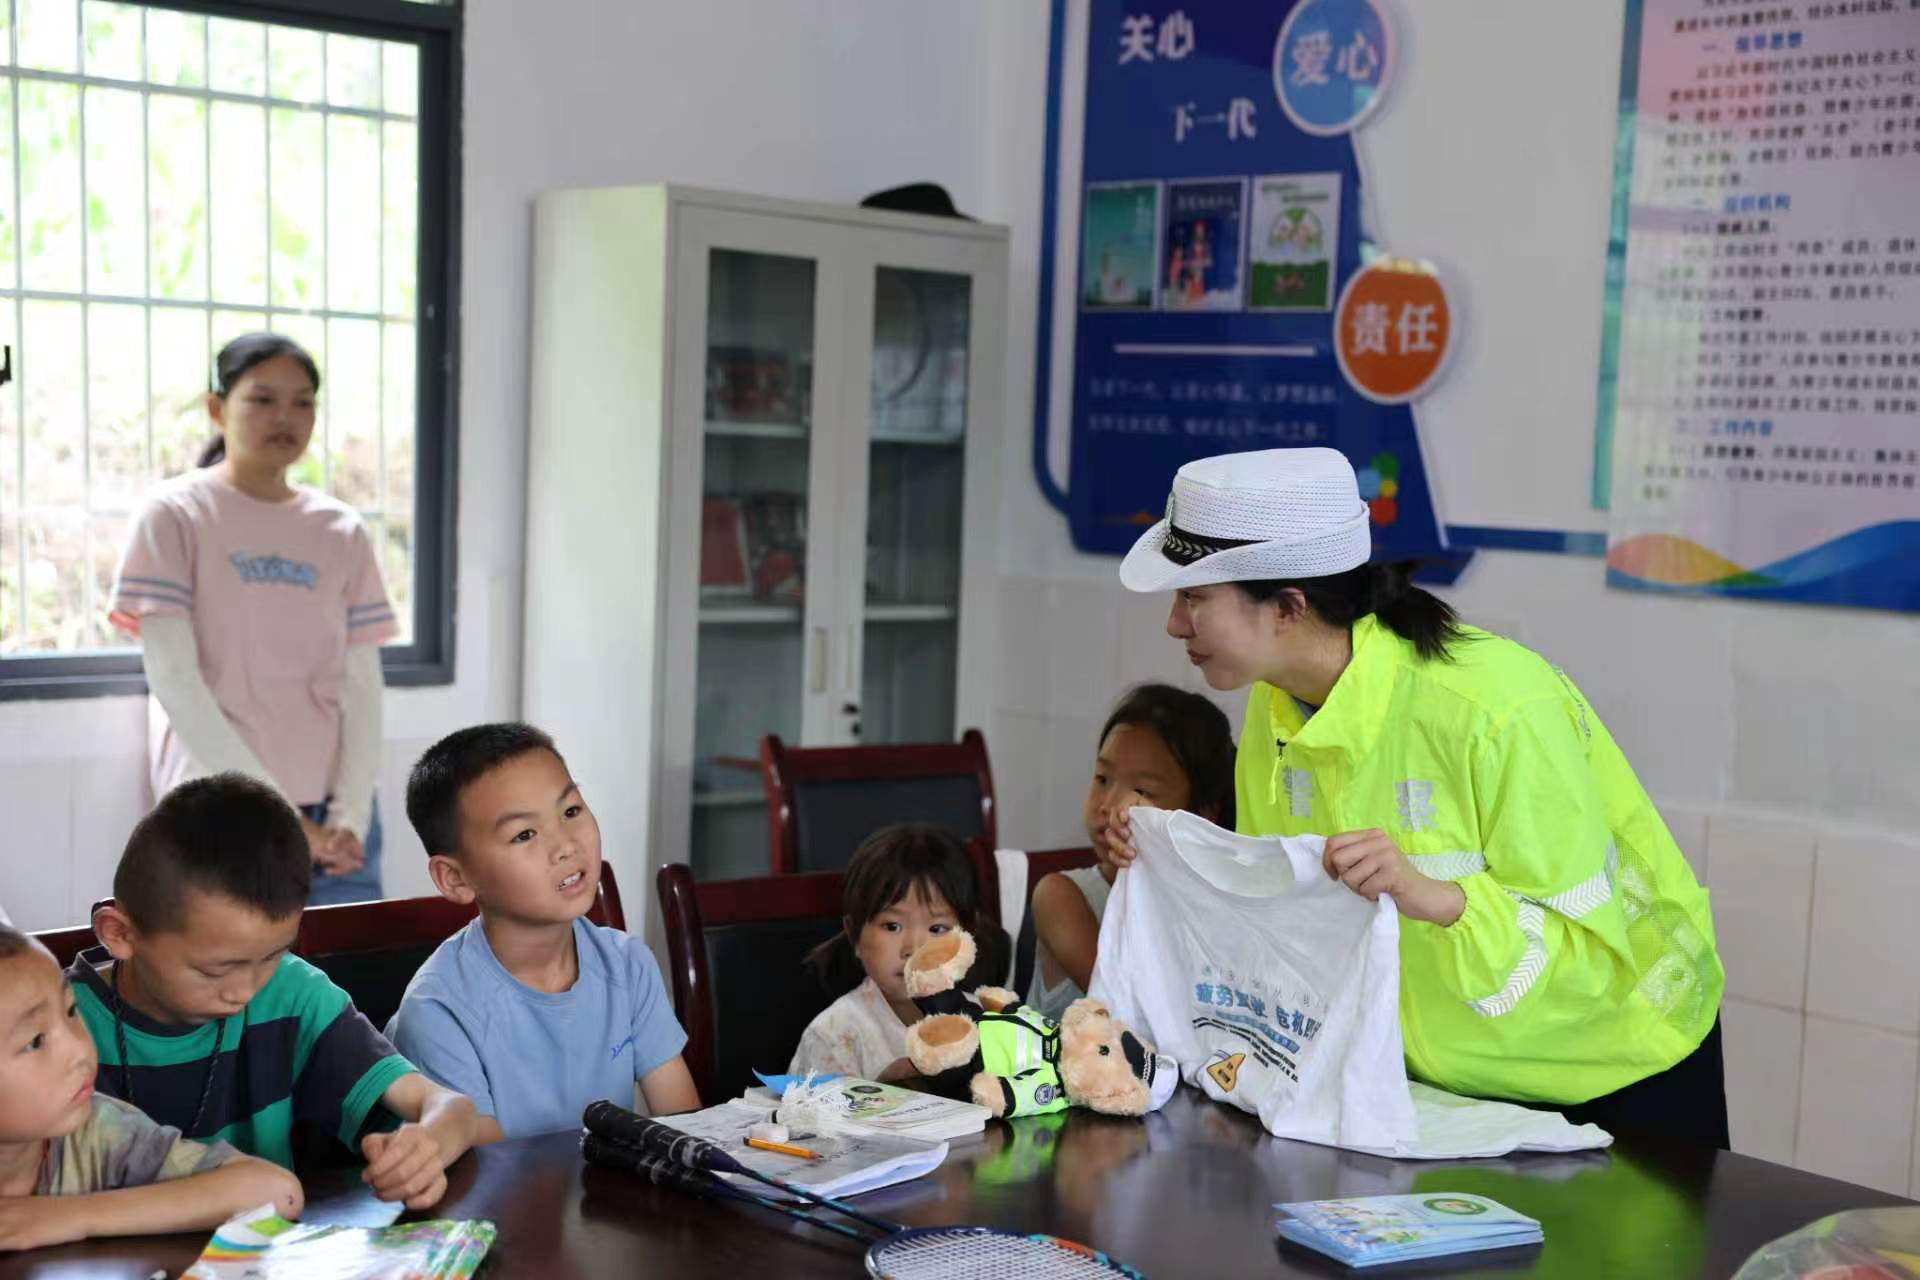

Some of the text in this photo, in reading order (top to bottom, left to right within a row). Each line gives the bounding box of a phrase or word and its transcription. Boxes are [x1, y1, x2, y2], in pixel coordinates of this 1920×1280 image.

[1119, 11, 1195, 64] 关心
[1291, 31, 1378, 86] 爱心
[1172, 98, 1257, 142] 下一代
[1351, 300, 1439, 357] 责任
